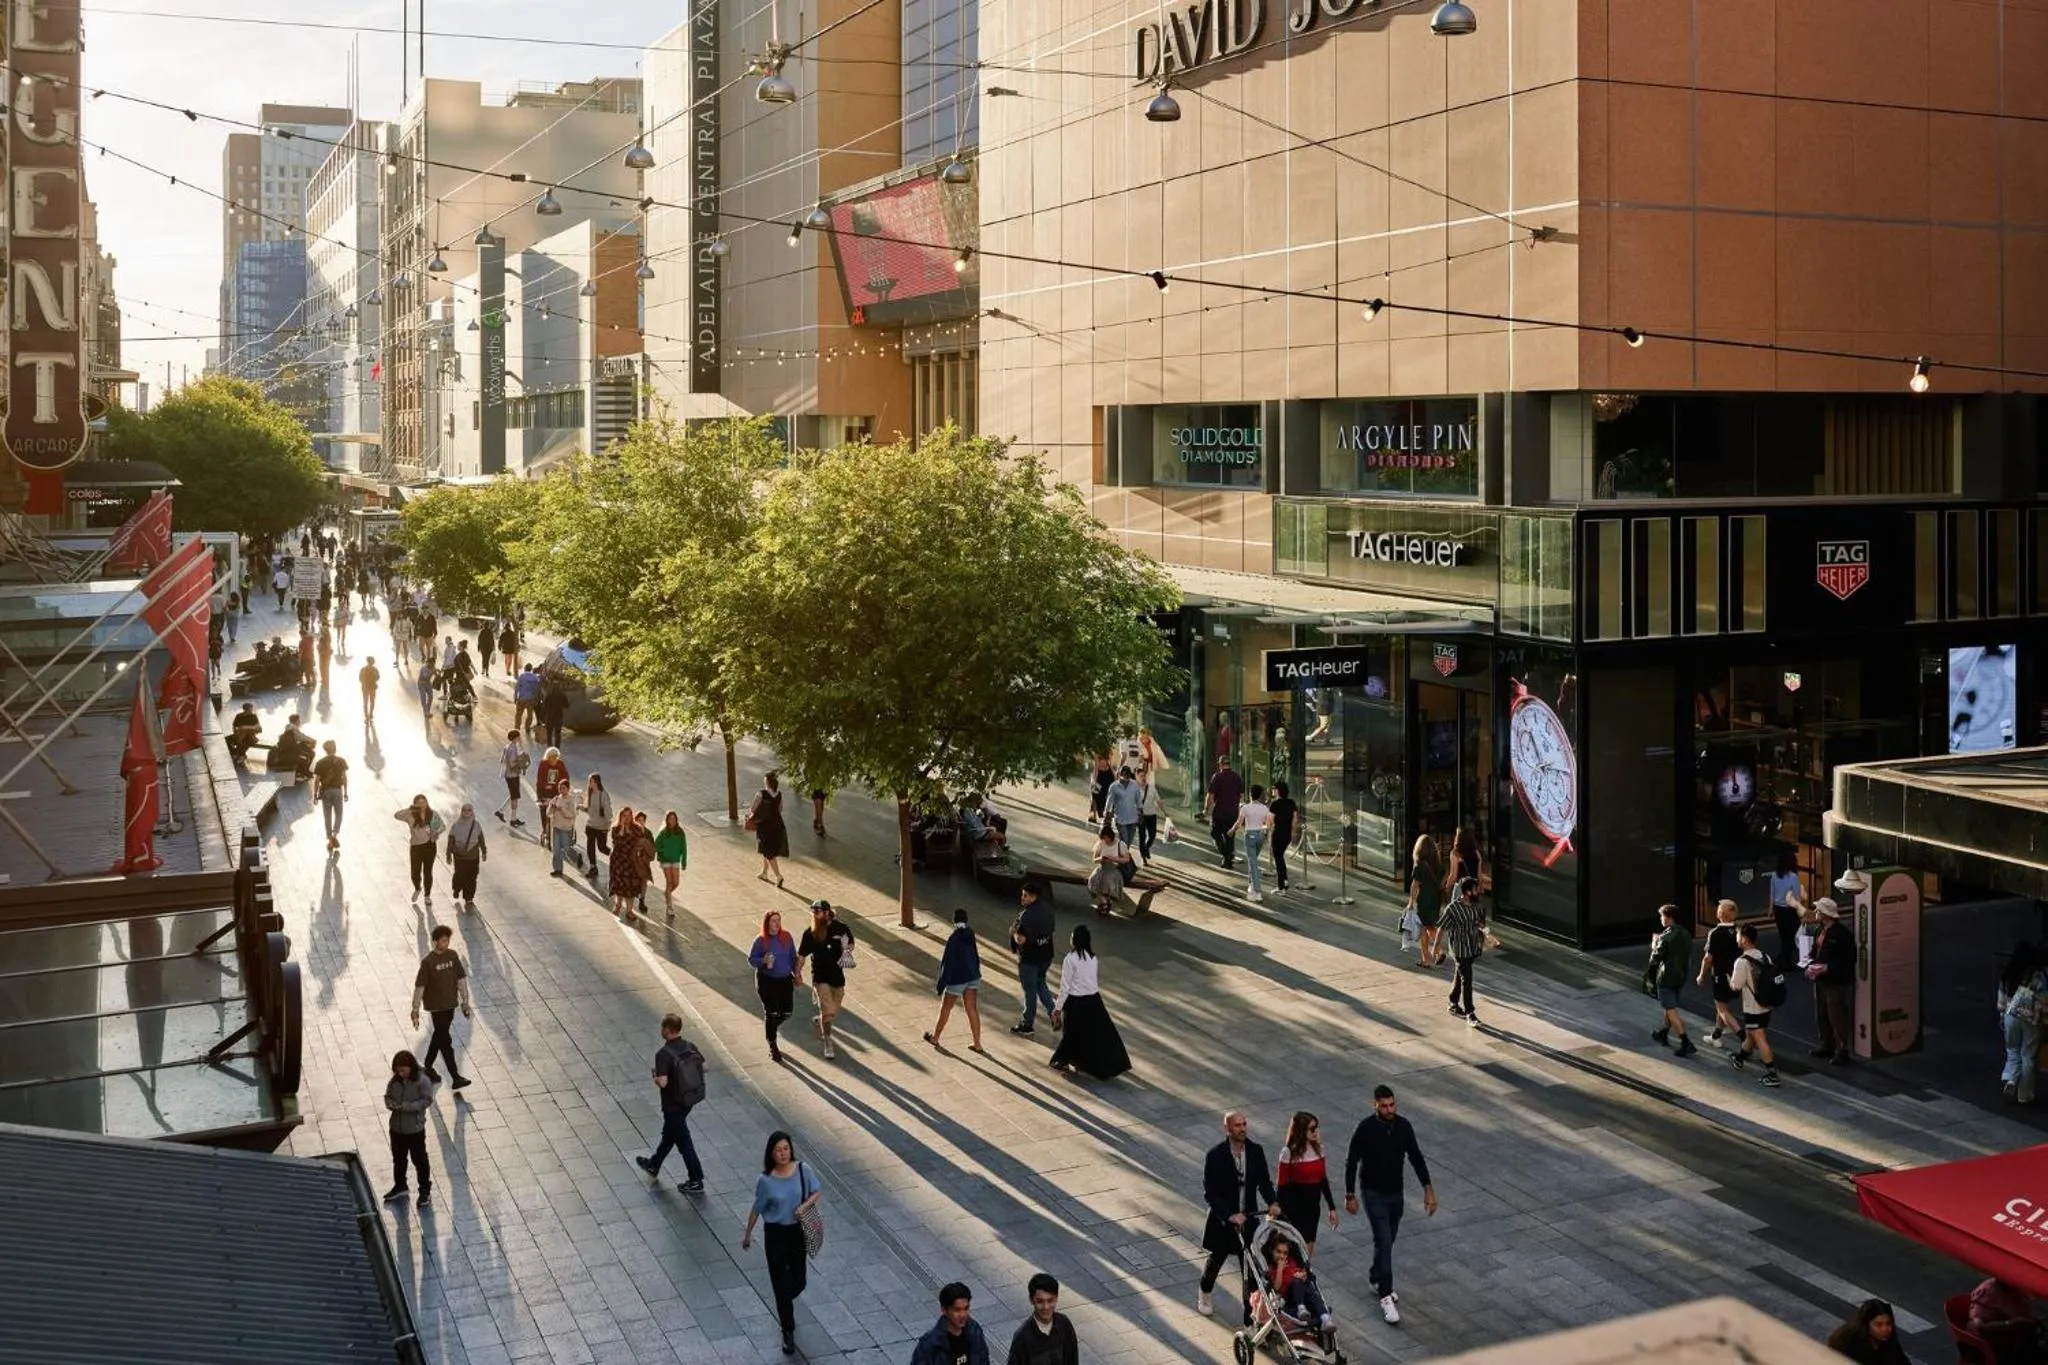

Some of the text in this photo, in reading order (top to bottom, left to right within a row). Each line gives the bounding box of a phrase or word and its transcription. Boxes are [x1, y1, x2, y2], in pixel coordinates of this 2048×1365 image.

[1136, 0, 1264, 86] DAVID
[699, 231, 715, 364] ADELAIDE
[13, 437, 78, 454] ARCADE
[1336, 425, 1423, 450] ARGYLE
[1180, 449, 1257, 464] DIAMONDS
[1821, 545, 1864, 562] TAG
[1820, 567, 1866, 595] HEUER
[1436, 646, 1455, 658] TAG
